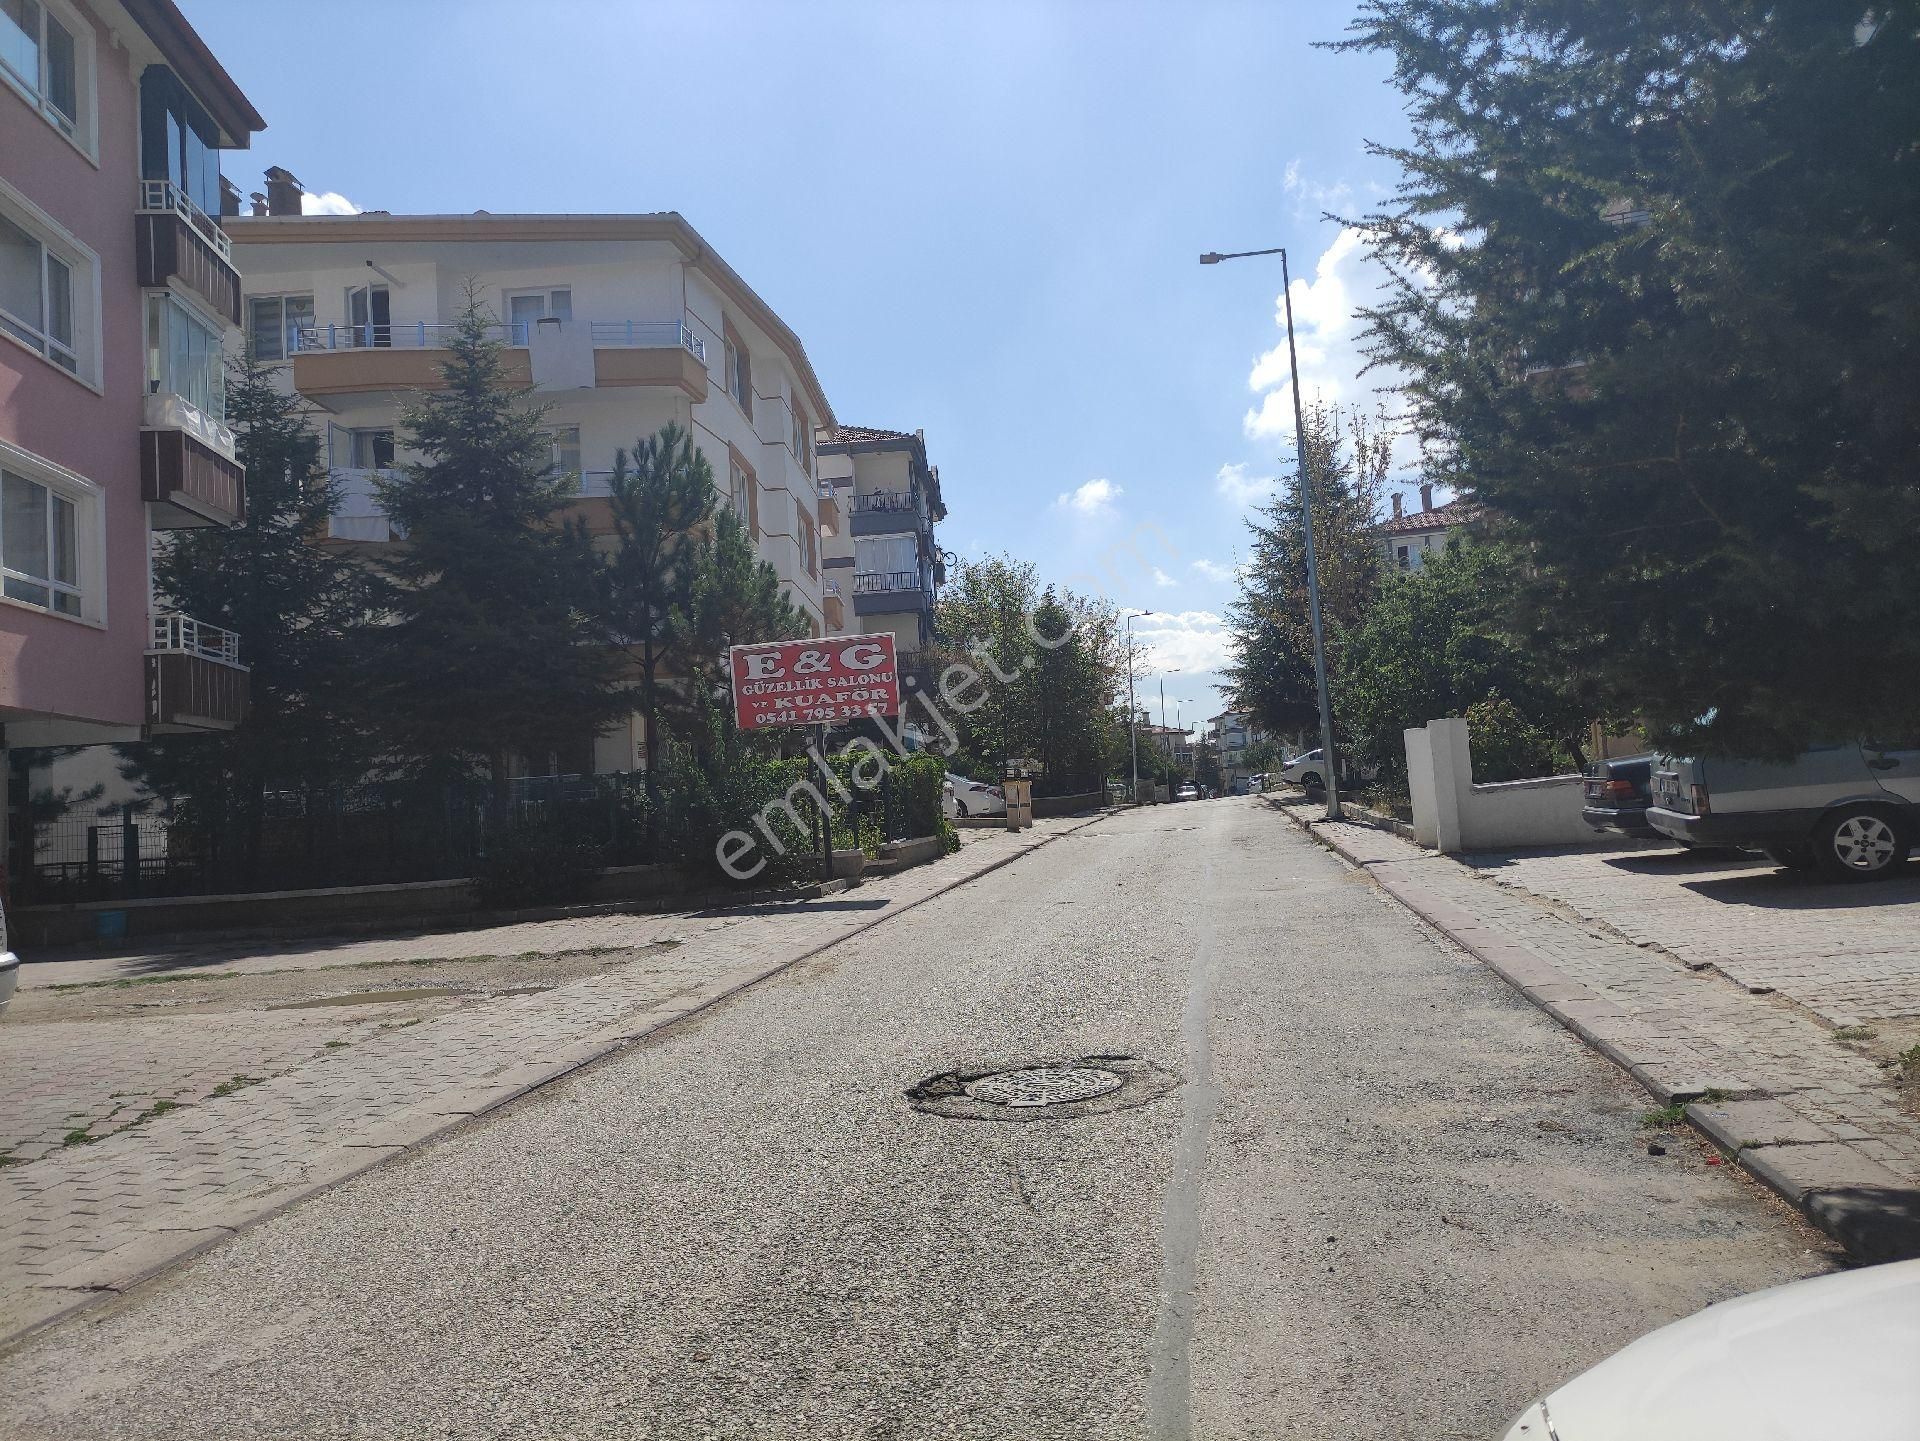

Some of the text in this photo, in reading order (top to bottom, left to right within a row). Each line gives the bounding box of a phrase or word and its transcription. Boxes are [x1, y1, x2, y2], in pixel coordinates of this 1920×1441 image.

[743, 643, 887, 679] E & G
[742, 672, 893, 696] GÜZELLİK SALONU
[774, 688, 889, 709] KUAFÖR
[755, 710, 798, 724] 0541
[803, 707, 836, 721] 795
[841, 705, 862, 717] 33
